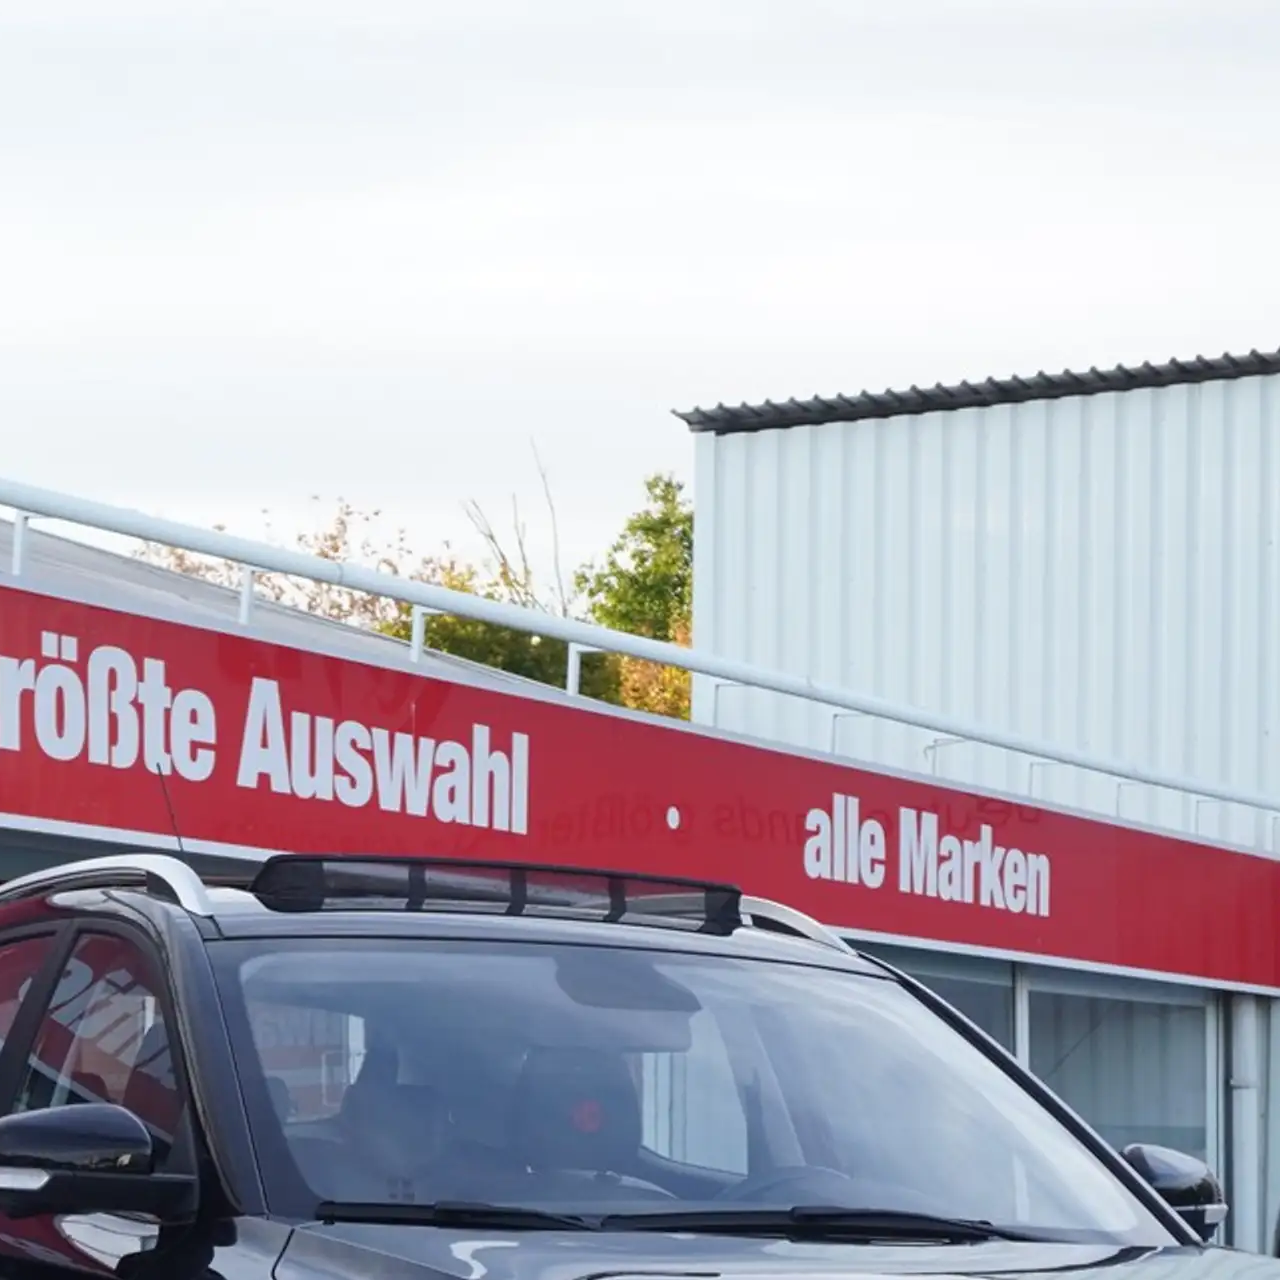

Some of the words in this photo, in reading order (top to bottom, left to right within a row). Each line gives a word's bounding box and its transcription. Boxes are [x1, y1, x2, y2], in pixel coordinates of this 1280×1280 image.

[236, 676, 530, 836] Auswahl
[803, 792, 887, 889] alle
[898, 806, 1051, 917] Marken
